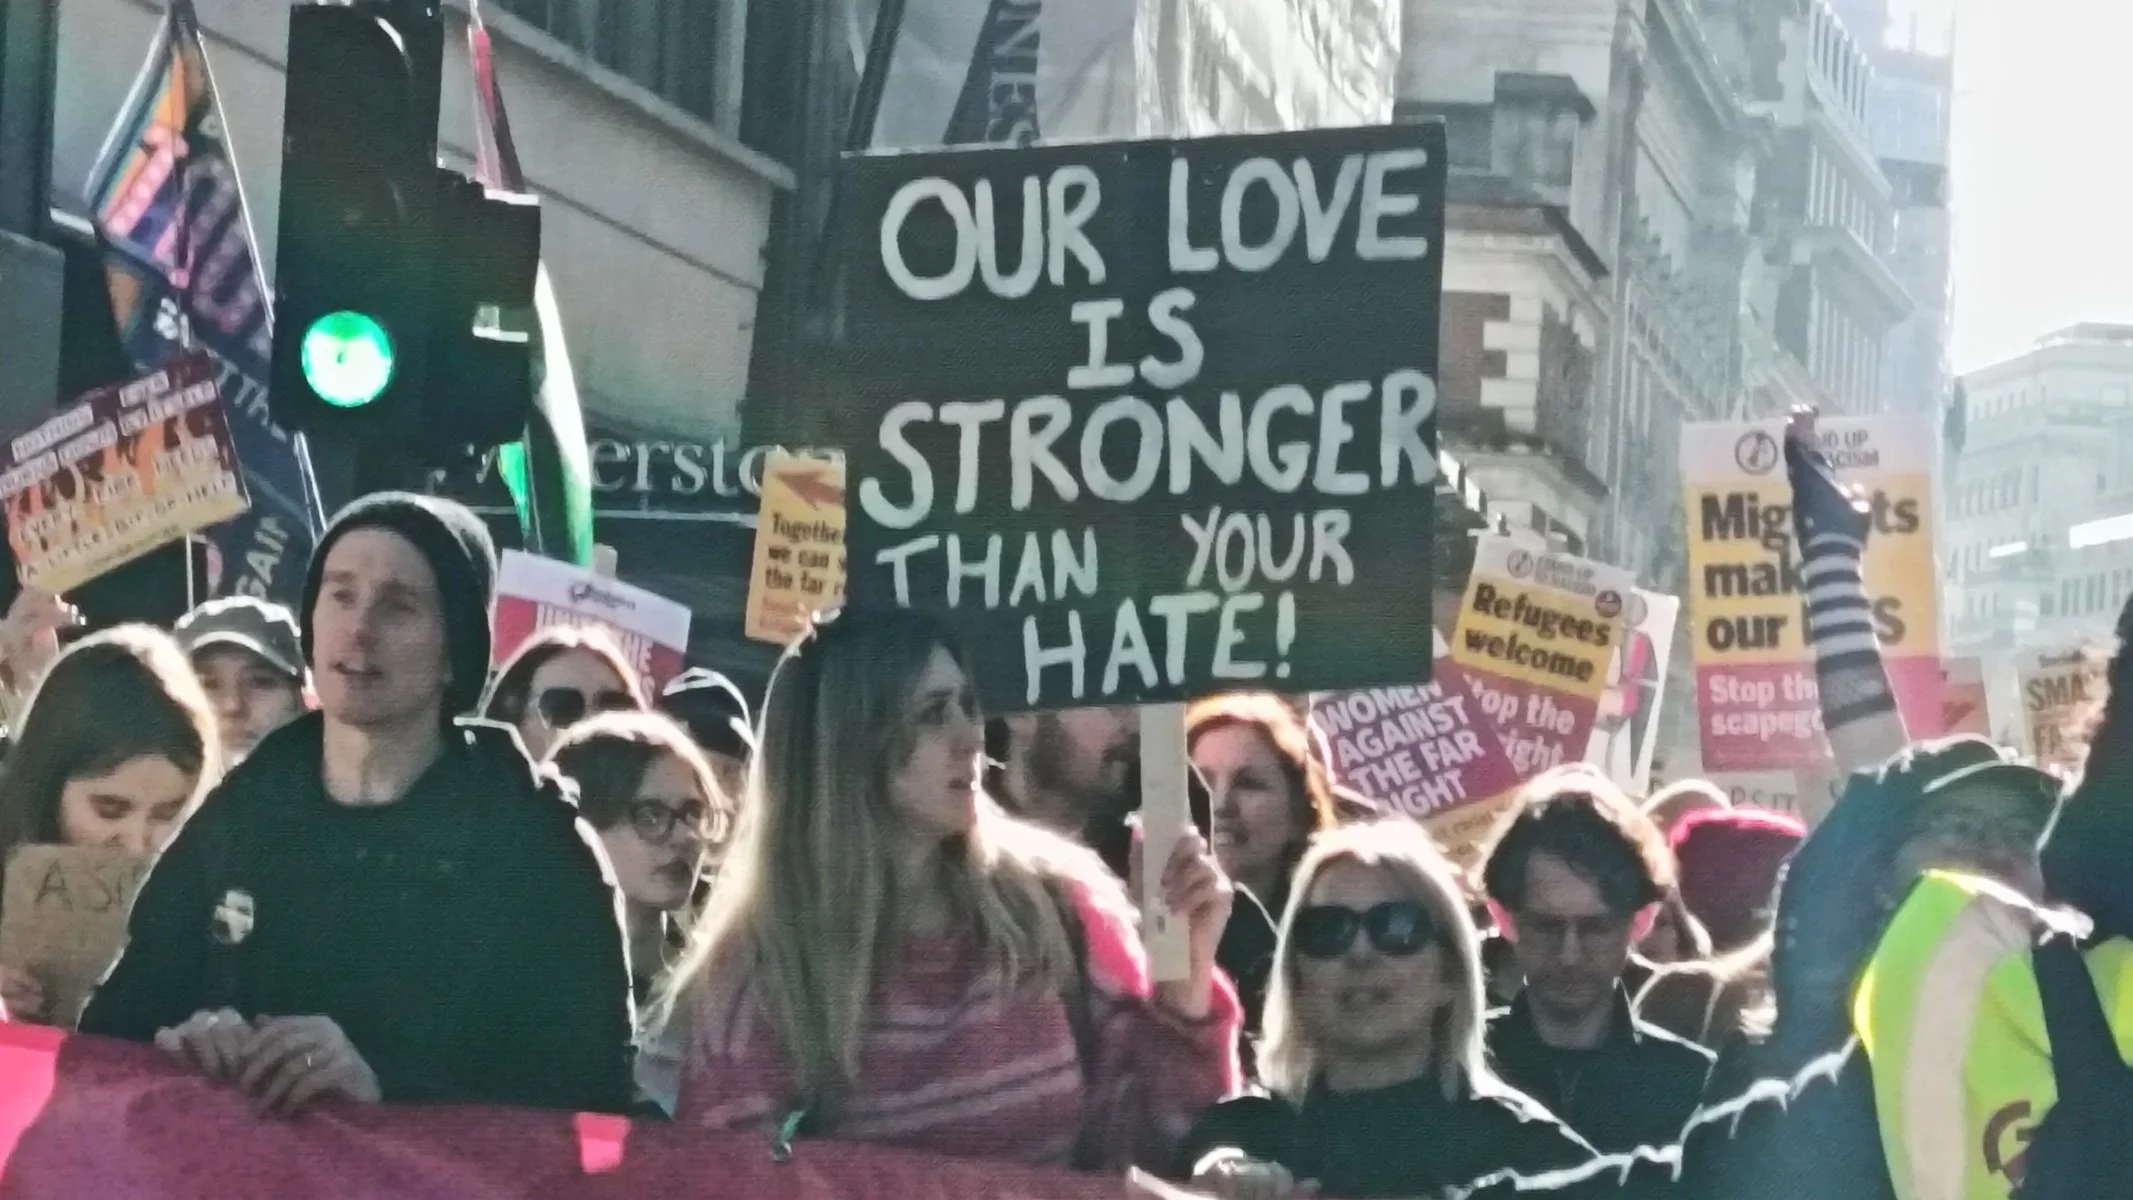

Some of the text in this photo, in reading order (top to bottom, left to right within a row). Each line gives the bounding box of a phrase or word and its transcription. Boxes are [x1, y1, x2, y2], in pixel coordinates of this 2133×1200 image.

[880, 149, 1428, 300] OUR LOVE
[1067, 287, 1204, 390] IS
[859, 370, 1438, 529] STRONGER
[1700, 488, 1920, 551] Migts
[765, 566, 793, 591] the
[767, 546, 792, 565] we
[798, 549, 830, 569] can
[876, 505, 1354, 608] THAN YOUR
[1704, 549, 1805, 597] mak
[1473, 581, 1611, 648] Refugees
[1706, 613, 1789, 651] our
[1023, 591, 1296, 706] HATE!
[1465, 627, 1594, 683] welcome
[1314, 680, 1443, 738] WOMEN
[1526, 693, 1576, 735] the
[1708, 672, 1819, 707] Stop th
[1335, 696, 1470, 769] AGAINST
[1351, 729, 1487, 799] THE FAR
[1386, 768, 1467, 820] IGHT
